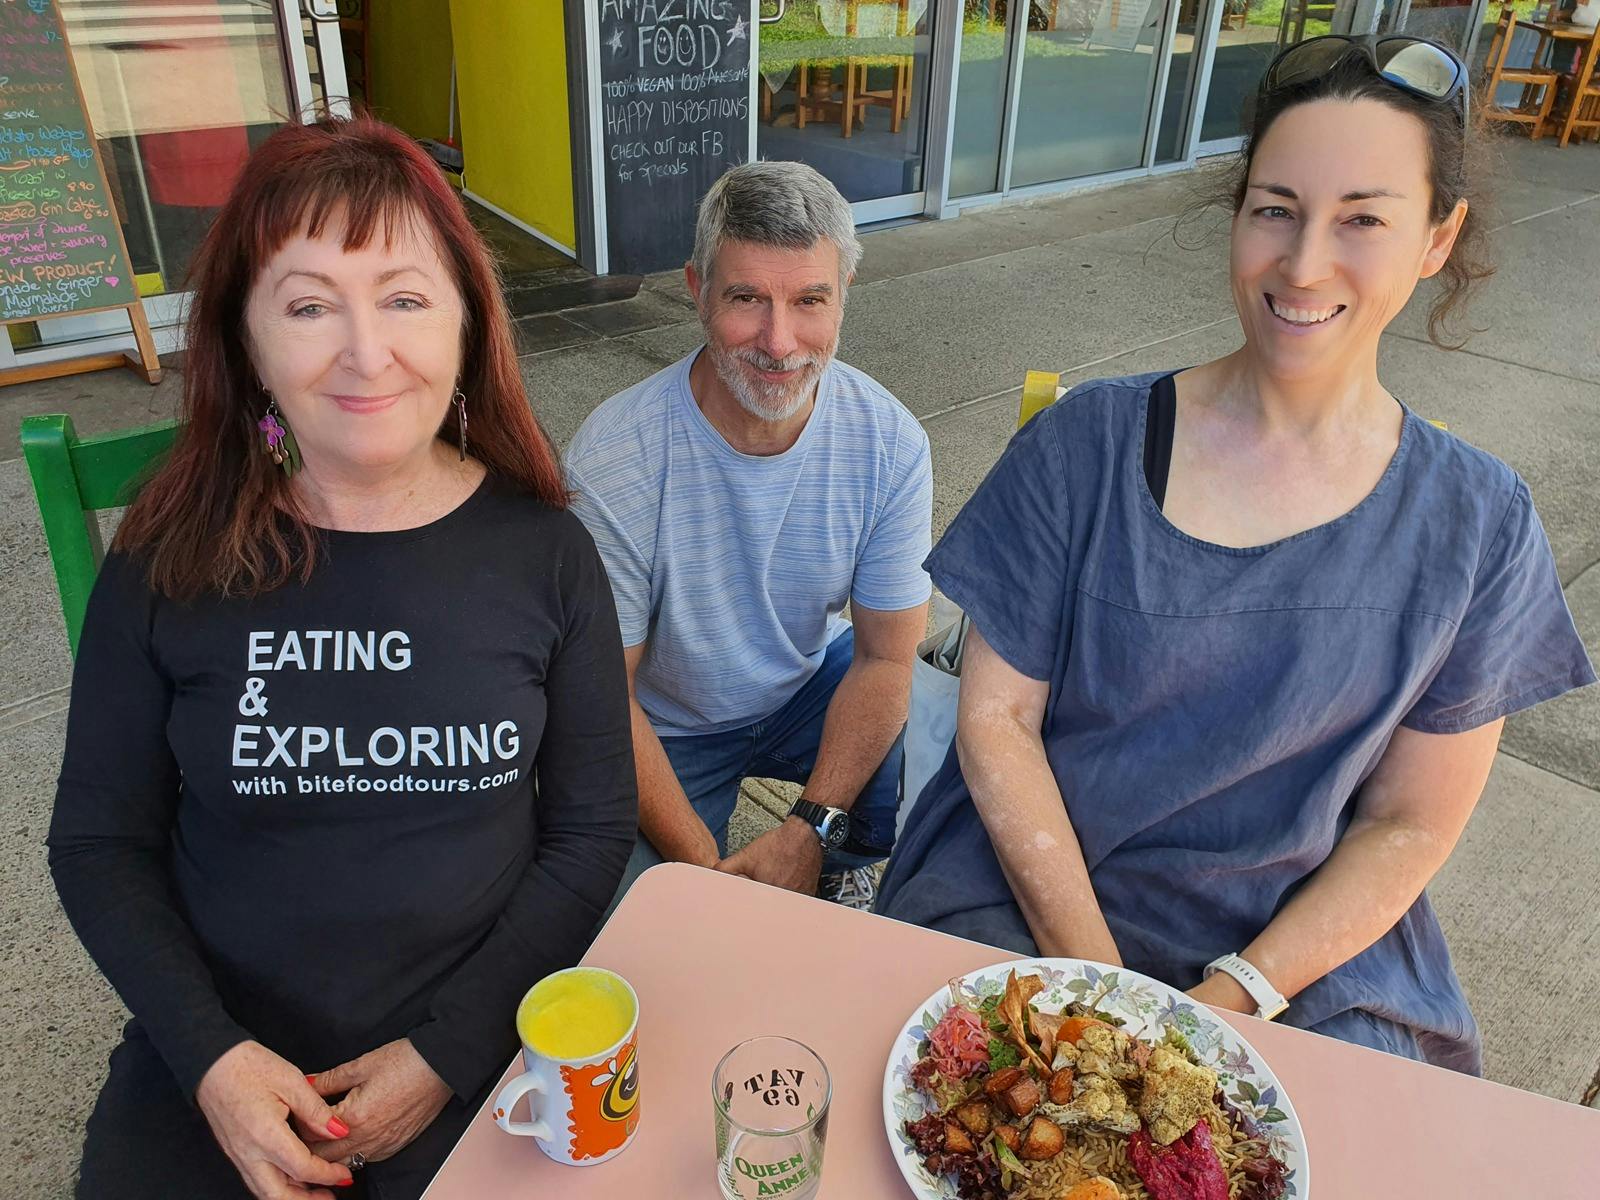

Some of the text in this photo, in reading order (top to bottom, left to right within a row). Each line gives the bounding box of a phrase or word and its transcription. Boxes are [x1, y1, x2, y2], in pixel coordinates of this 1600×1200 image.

[602, 0, 732, 24] AMAZING
[638, 24, 721, 70] FOOD
[607, 75, 635, 98] 100%
[637, 75, 674, 92] VEGAN
[681, 69, 706, 93] 100%
[606, 96, 748, 135] HAPPY DISPOSITIONS
[611, 142, 651, 161] CHECK
[654, 136, 676, 155] OUT
[702, 130, 723, 156] FB
[618, 163, 634, 184] for
[33, 253, 116, 282] PRODUCT!
[6, 286, 79, 310] Marmalade
[248, 630, 412, 671] EATING
[238, 677, 268, 717] &
[232, 720, 520, 768] EXPLORING
[232, 768, 519, 795] with bitefoodtours.com
[734, 1152, 804, 1180] QUEEN
[758, 1167, 810, 1196] ANNE
